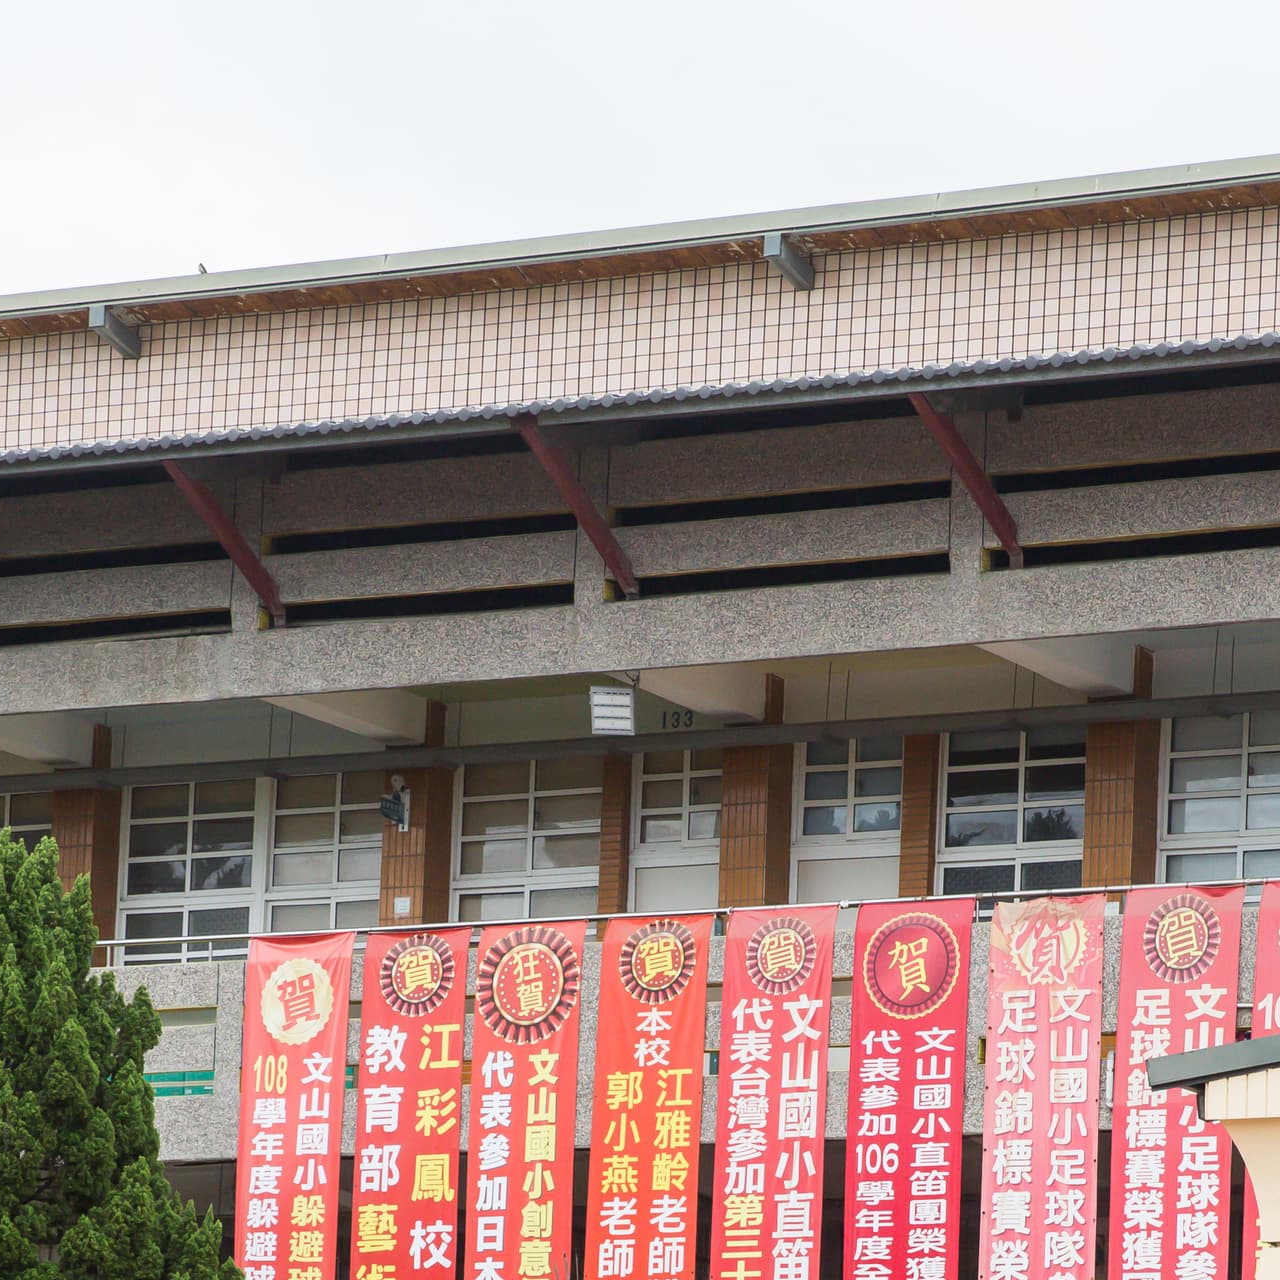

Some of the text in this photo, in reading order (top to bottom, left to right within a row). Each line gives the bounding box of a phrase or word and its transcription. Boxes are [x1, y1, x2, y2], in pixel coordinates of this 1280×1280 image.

[661, 710, 694, 729] 133
[759, 928, 800, 978] 賀
[1019, 904, 1081, 985] 賀
[1158, 904, 1202, 963] 賀
[394, 946, 441, 998] 賀
[510, 952, 547, 1020] 狂賀
[638, 940, 678, 987] 賀
[888, 938, 932, 998] 賀
[276, 977, 318, 1029] 賀
[634, 1009, 673, 1067] 本校
